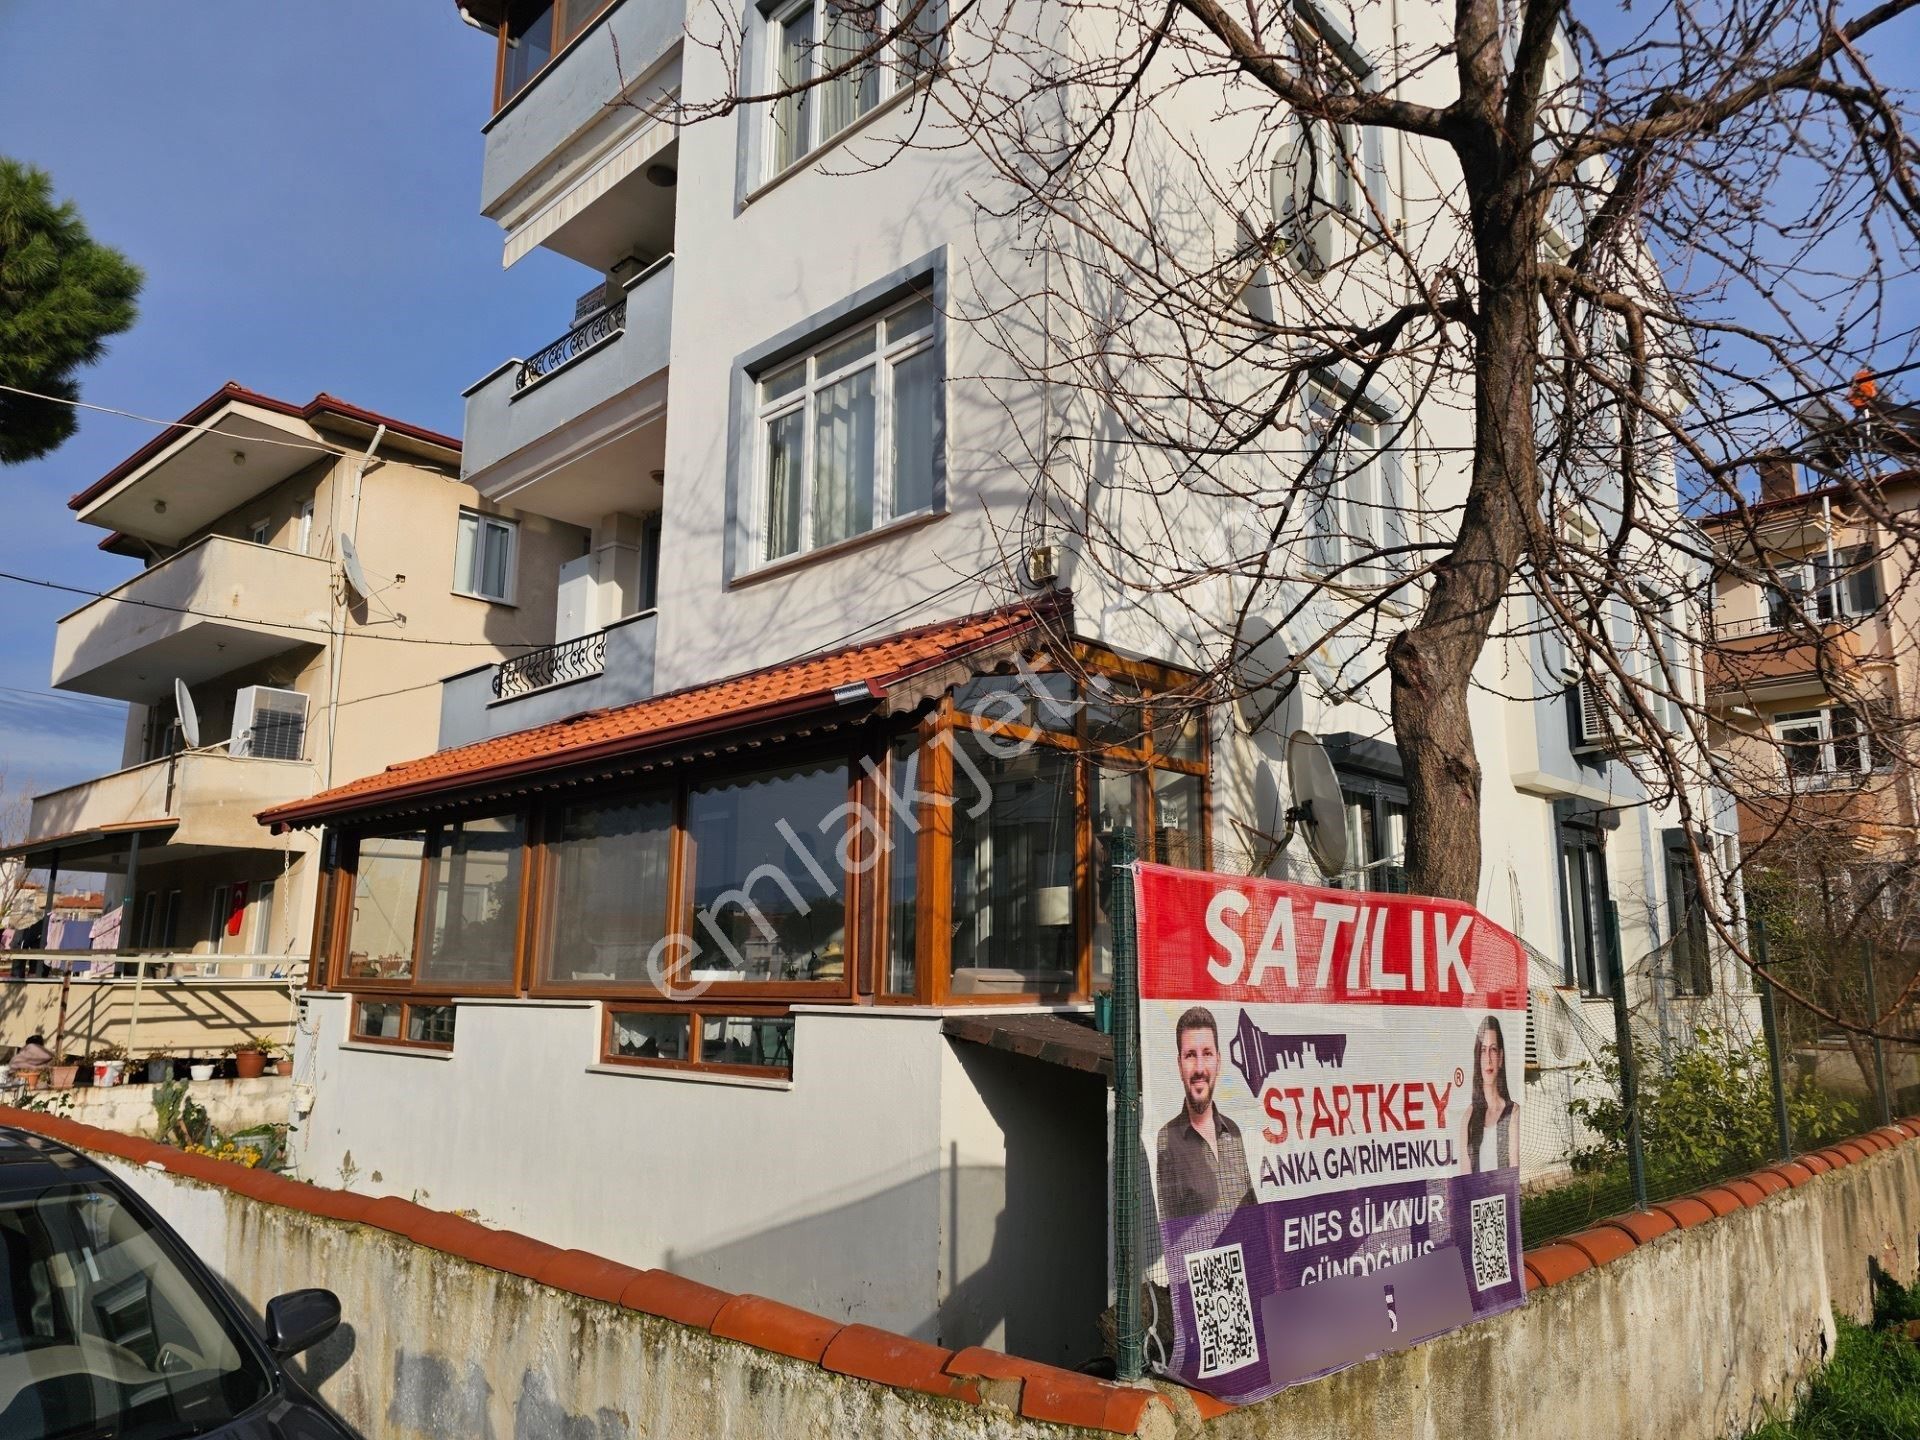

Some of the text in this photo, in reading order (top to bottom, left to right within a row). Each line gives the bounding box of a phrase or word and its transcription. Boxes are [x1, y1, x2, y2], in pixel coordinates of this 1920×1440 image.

[1205, 889, 1476, 994] SATILIK
[1260, 1139, 1458, 1188] ANKA GAYRİMENKUL
[1284, 1210, 1342, 1252] ENES
